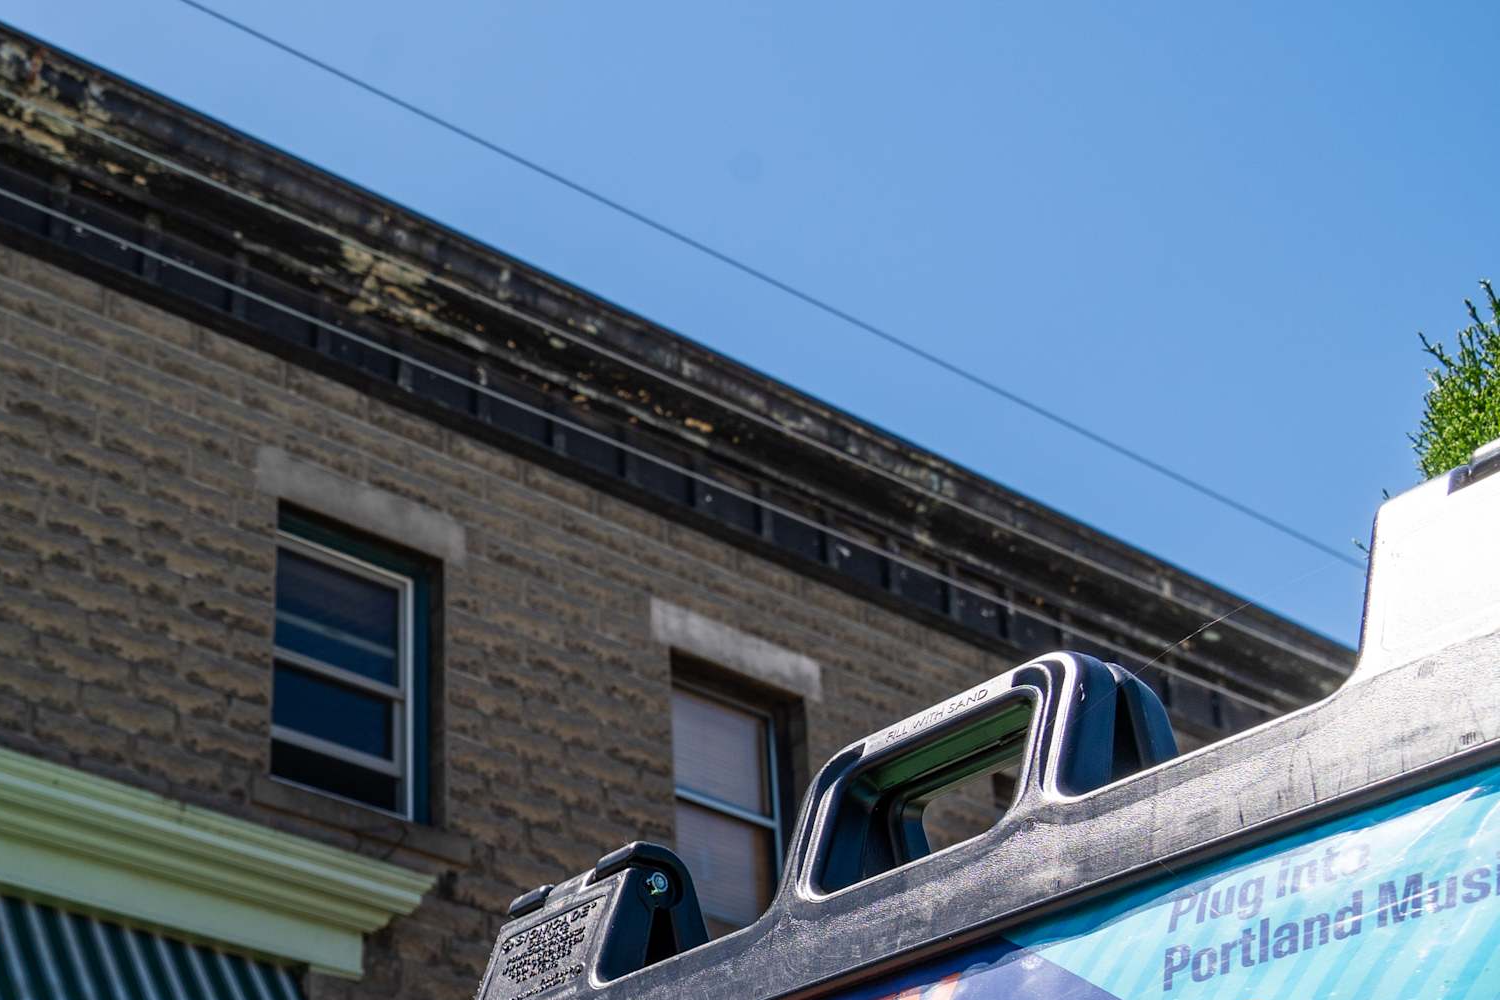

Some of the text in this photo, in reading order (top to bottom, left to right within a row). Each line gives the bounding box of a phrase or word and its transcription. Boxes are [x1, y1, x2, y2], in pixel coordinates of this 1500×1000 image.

[913, 710, 945, 729] WITH
[947, 688, 989, 715] SAND
[1167, 875, 1265, 934] Plug
[1163, 889, 1364, 991] Portland
